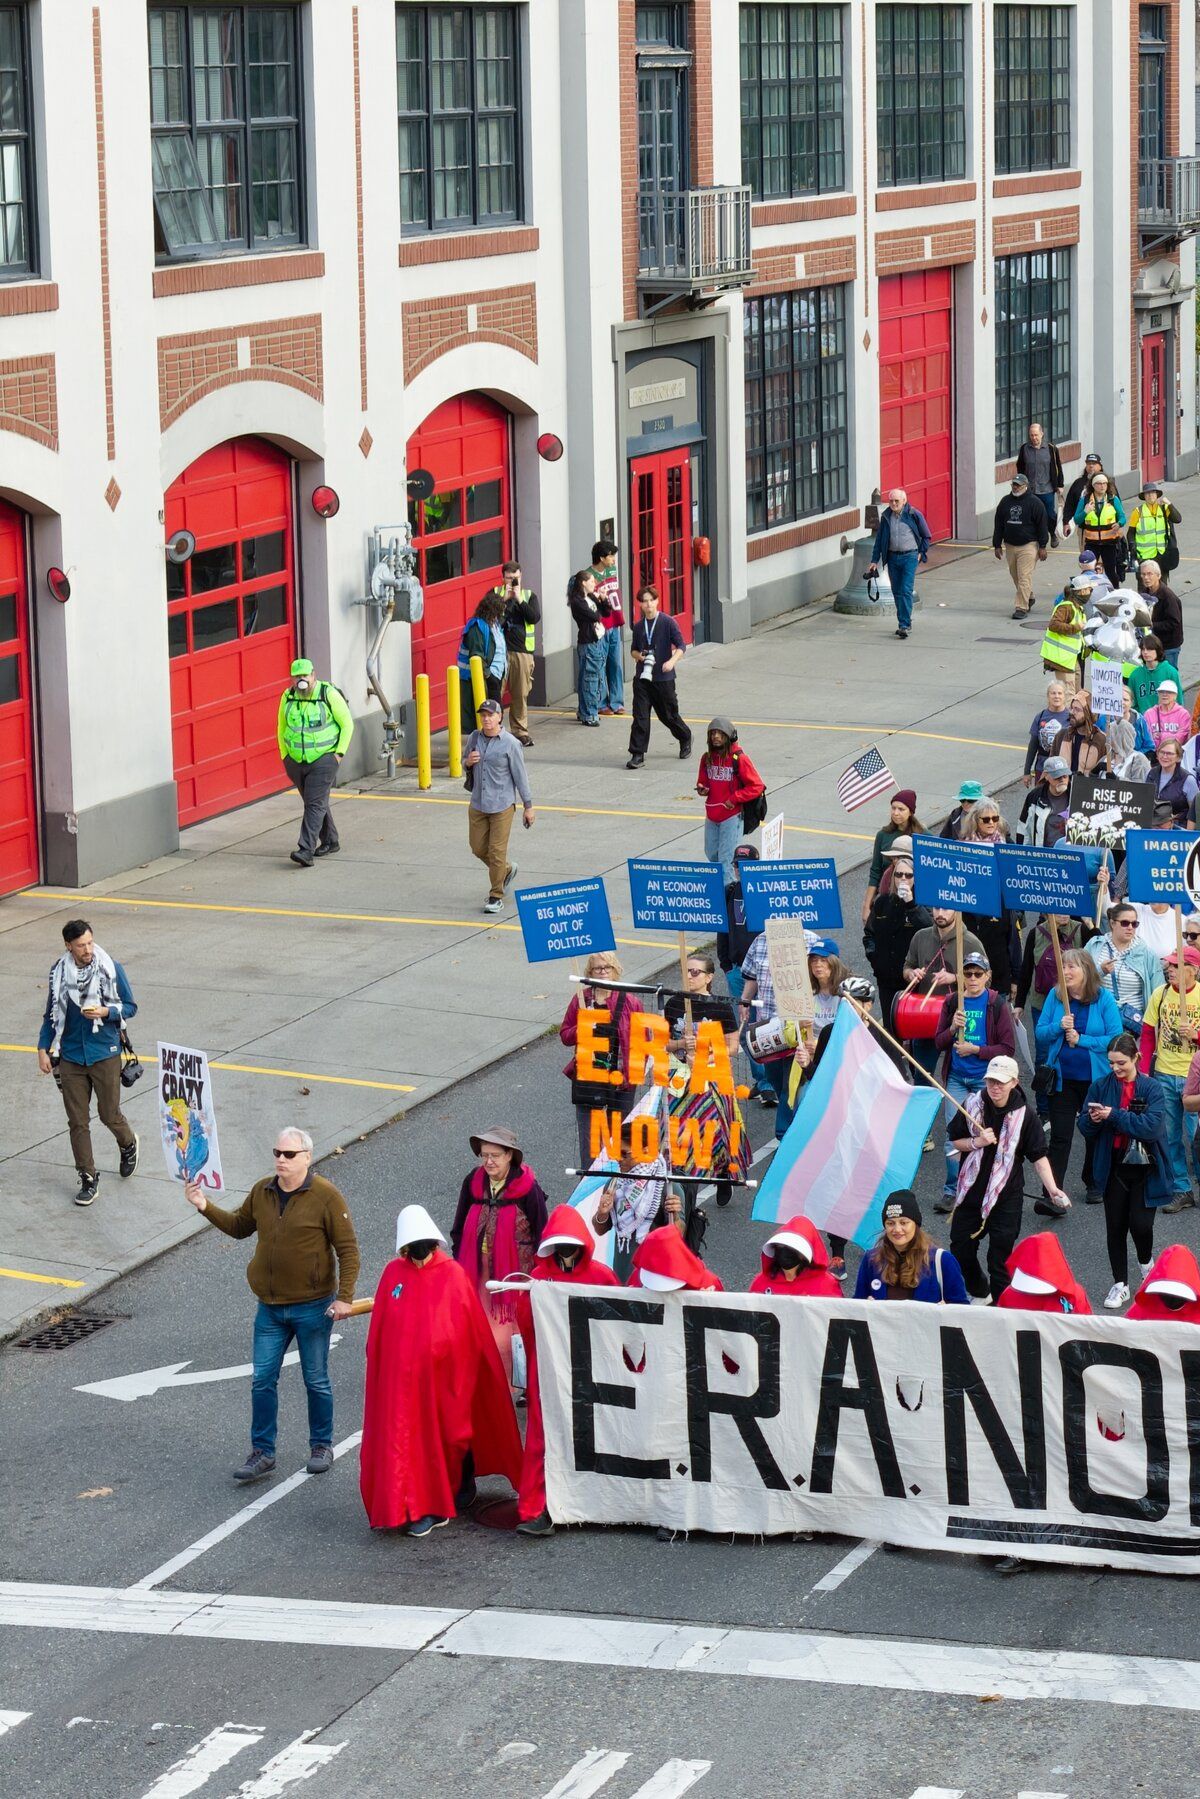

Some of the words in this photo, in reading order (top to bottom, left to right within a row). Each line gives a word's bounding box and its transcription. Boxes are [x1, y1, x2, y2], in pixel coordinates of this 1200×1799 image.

[1092, 697, 1122, 712] IMPEACH
[1093, 789, 1116, 802] RISE
[1119, 790, 1132, 804] UP
[1082, 801, 1096, 810] FOR
[920, 855, 951, 870] RACIAL
[955, 860, 992, 876] JUSTICE
[1017, 864, 1059, 879] POLITICS
[1061, 869, 1068, 880] &
[647, 880, 661, 892] AN
[663, 881, 707, 894] ECONOMY
[746, 882, 755, 893] A
[757, 880, 798, 893] LIVABLE
[800, 878, 834, 891] EARTH
[948, 876, 966, 887] AND
[1006, 878, 1040, 892] COURTS
[1042, 882, 1084, 896] WITHOUT
[646, 896, 664, 907] FOR
[666, 896, 711, 910] WORKERS
[769, 896, 789, 908] FOR
[792, 894, 814, 907] OUR
[938, 889, 977, 905] HEALING
[1020, 894, 1076, 908] CORRUPTION
[536, 906, 555, 920] BIG
[558, 902, 590, 918] MONEY
[637, 910, 657, 922] NOT
[659, 910, 724, 925] BILLIONAIRES
[769, 911, 818, 922] CHILDREN
[550, 922, 569, 936] OUT
[572, 920, 584, 932] OF
[548, 934, 592, 952] POLITICS
[576, 1008, 750, 1098] E.R.A.
[162, 1049, 177, 1073] BAT
[179, 1052, 202, 1078] SHIT
[162, 1073, 204, 1110] CRAZY
[590, 1109, 742, 1172] NOW!
